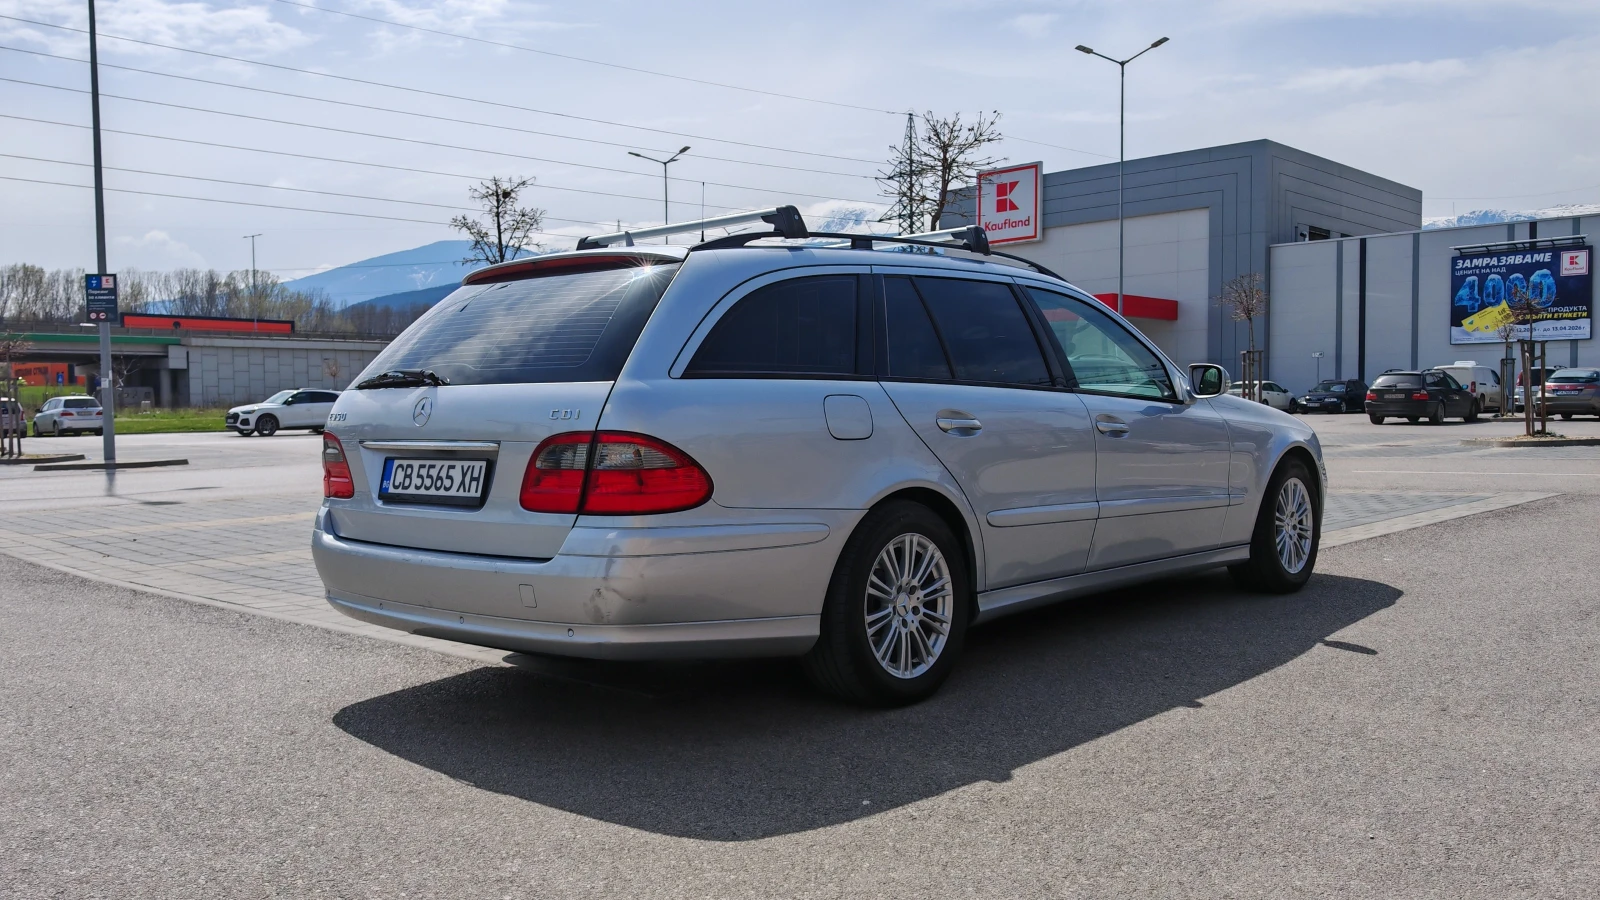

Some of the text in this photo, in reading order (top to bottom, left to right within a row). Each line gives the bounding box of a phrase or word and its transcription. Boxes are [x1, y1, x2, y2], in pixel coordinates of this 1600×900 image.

[996, 180, 1020, 213] K
[984, 216, 1031, 232] Kaufland
[1455, 252, 1552, 269] ЗАМРАЗЯВАМЕ
[1455, 268, 1480, 276] ЦЕНИТЕ
[1455, 269, 1557, 312] 4000
[1548, 305, 1587, 313] ПРОДУКТА
[549, 409, 581, 420] CDI
[392, 463, 483, 493] CB 5565 XH
